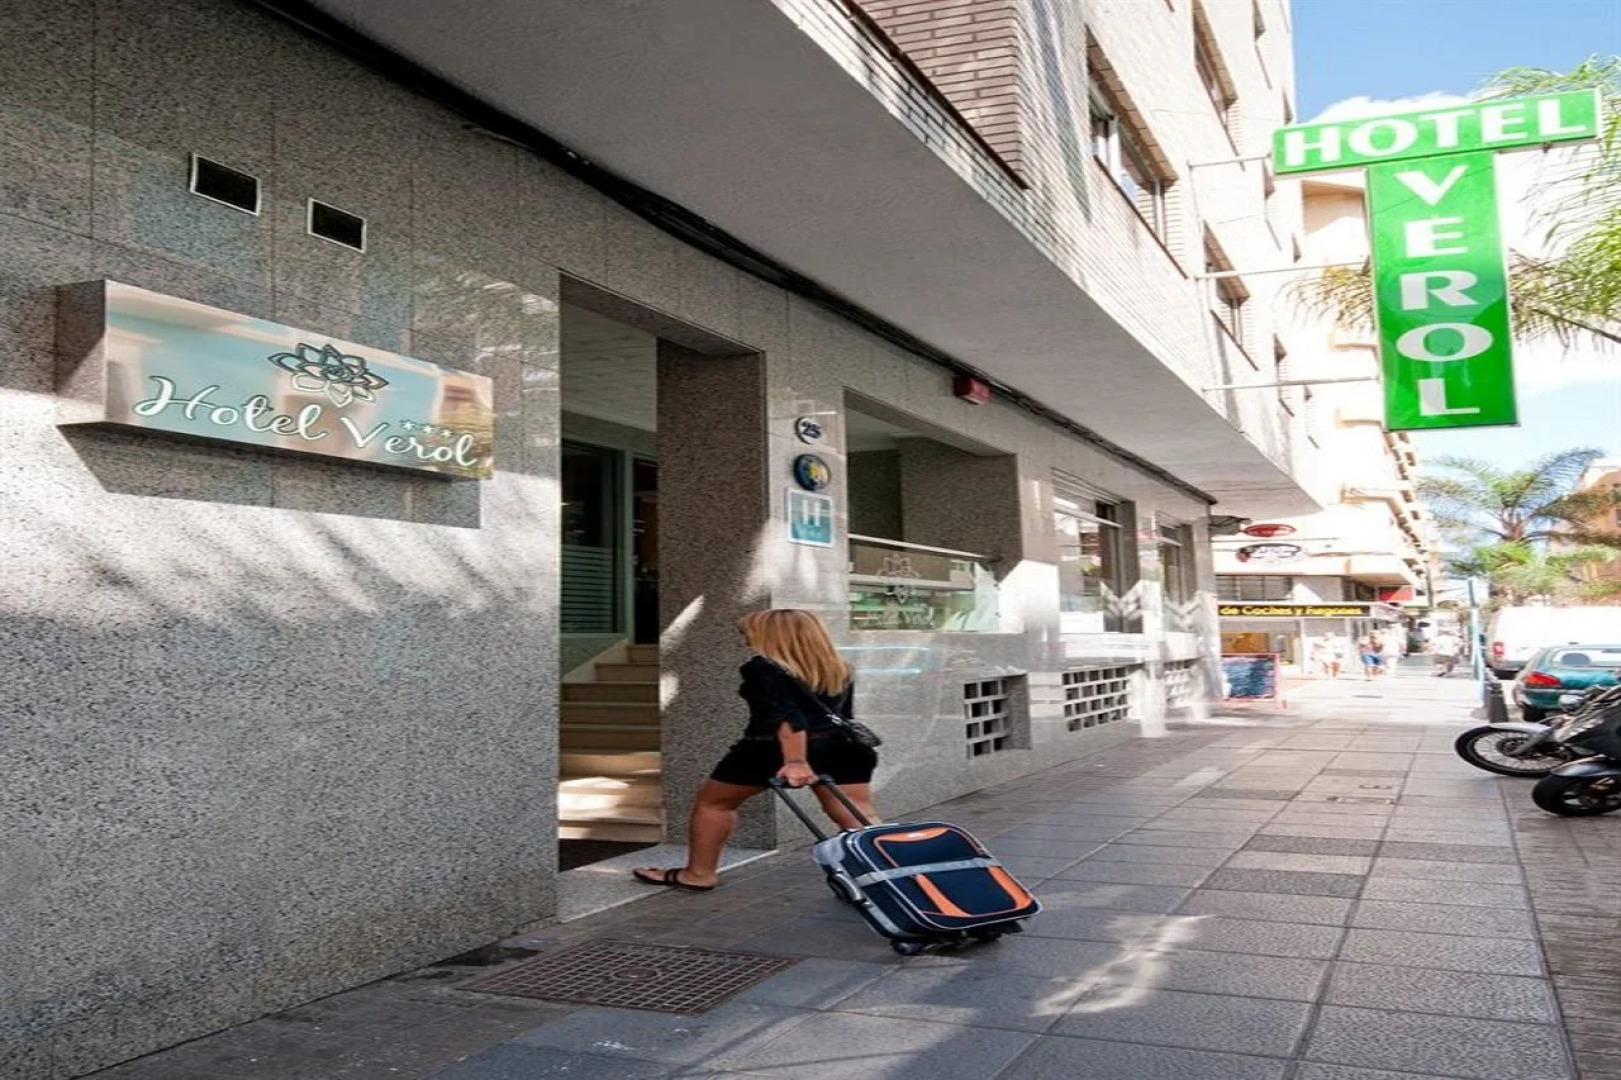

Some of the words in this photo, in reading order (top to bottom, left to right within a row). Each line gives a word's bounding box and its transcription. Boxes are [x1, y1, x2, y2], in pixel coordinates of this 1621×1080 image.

[1284, 98, 1587, 168] HOTEL
[1394, 164, 1495, 417] VEROL
[132, 375, 328, 441] Hotel
[340, 416, 478, 467] Verol
[1221, 605, 1239, 614] de
